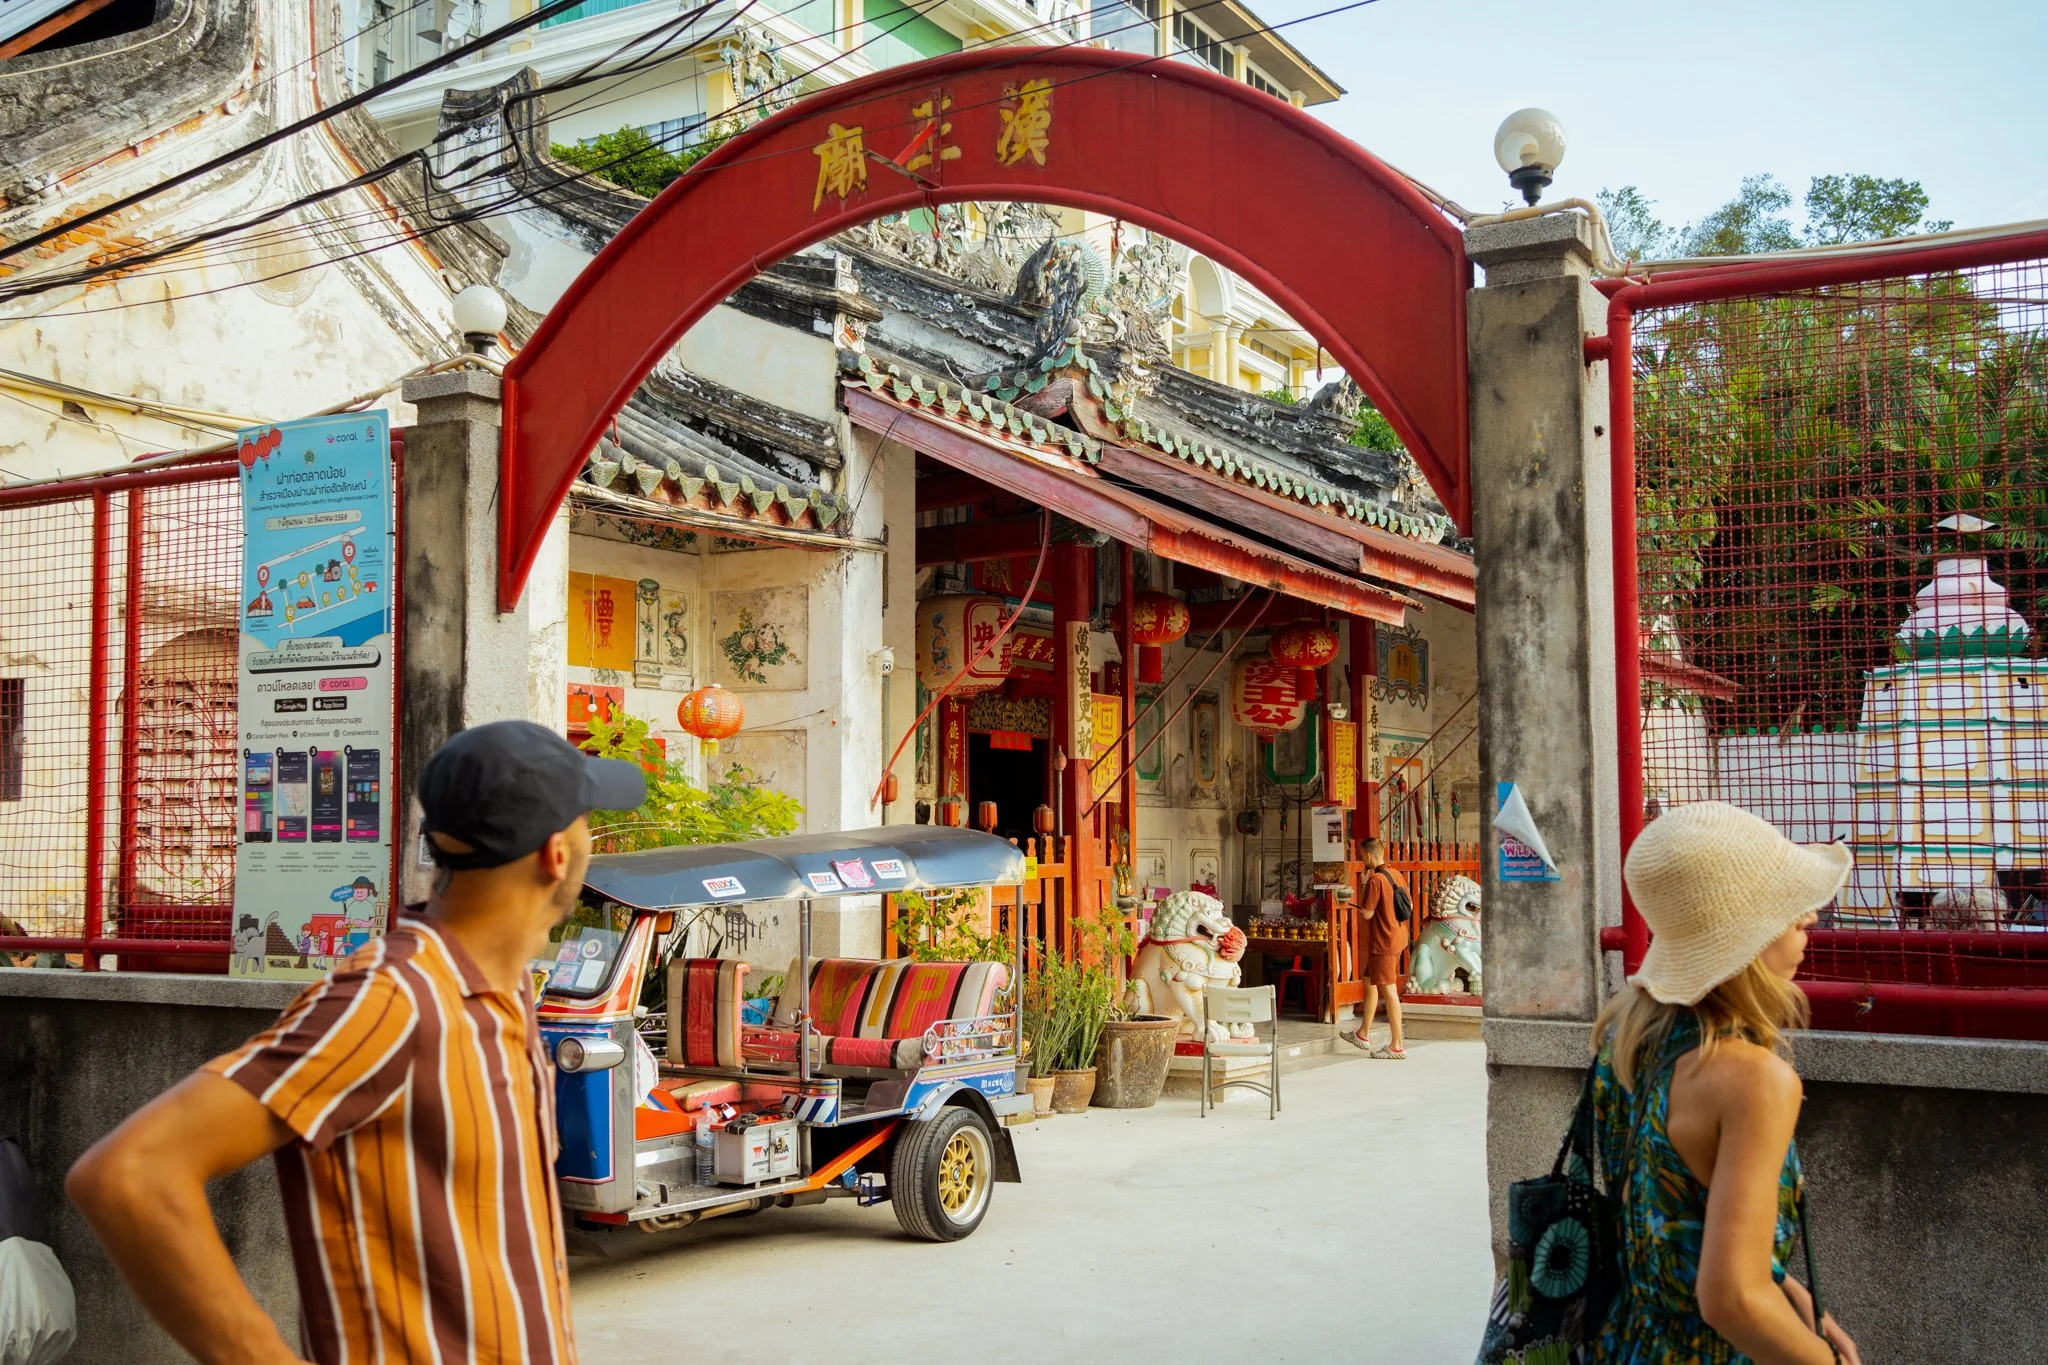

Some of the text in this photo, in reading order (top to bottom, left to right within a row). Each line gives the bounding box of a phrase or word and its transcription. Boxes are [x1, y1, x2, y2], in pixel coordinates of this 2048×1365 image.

[336, 432, 358, 443] coral
[276, 465, 346, 486] ฝาท่อตลาดน้อย
[257, 679, 316, 693] ดาวน์โหลดเลย!
[329, 680, 351, 688] coral
[1074, 627, 1092, 757] 萬象更新
[282, 702, 306, 711] Google Play
[315, 717, 362, 727] ที่สุดของความสุข
[264, 732, 278, 740] Super
[342, 729, 380, 737] Coralworld.co
[820, 965, 950, 1031] VIP
